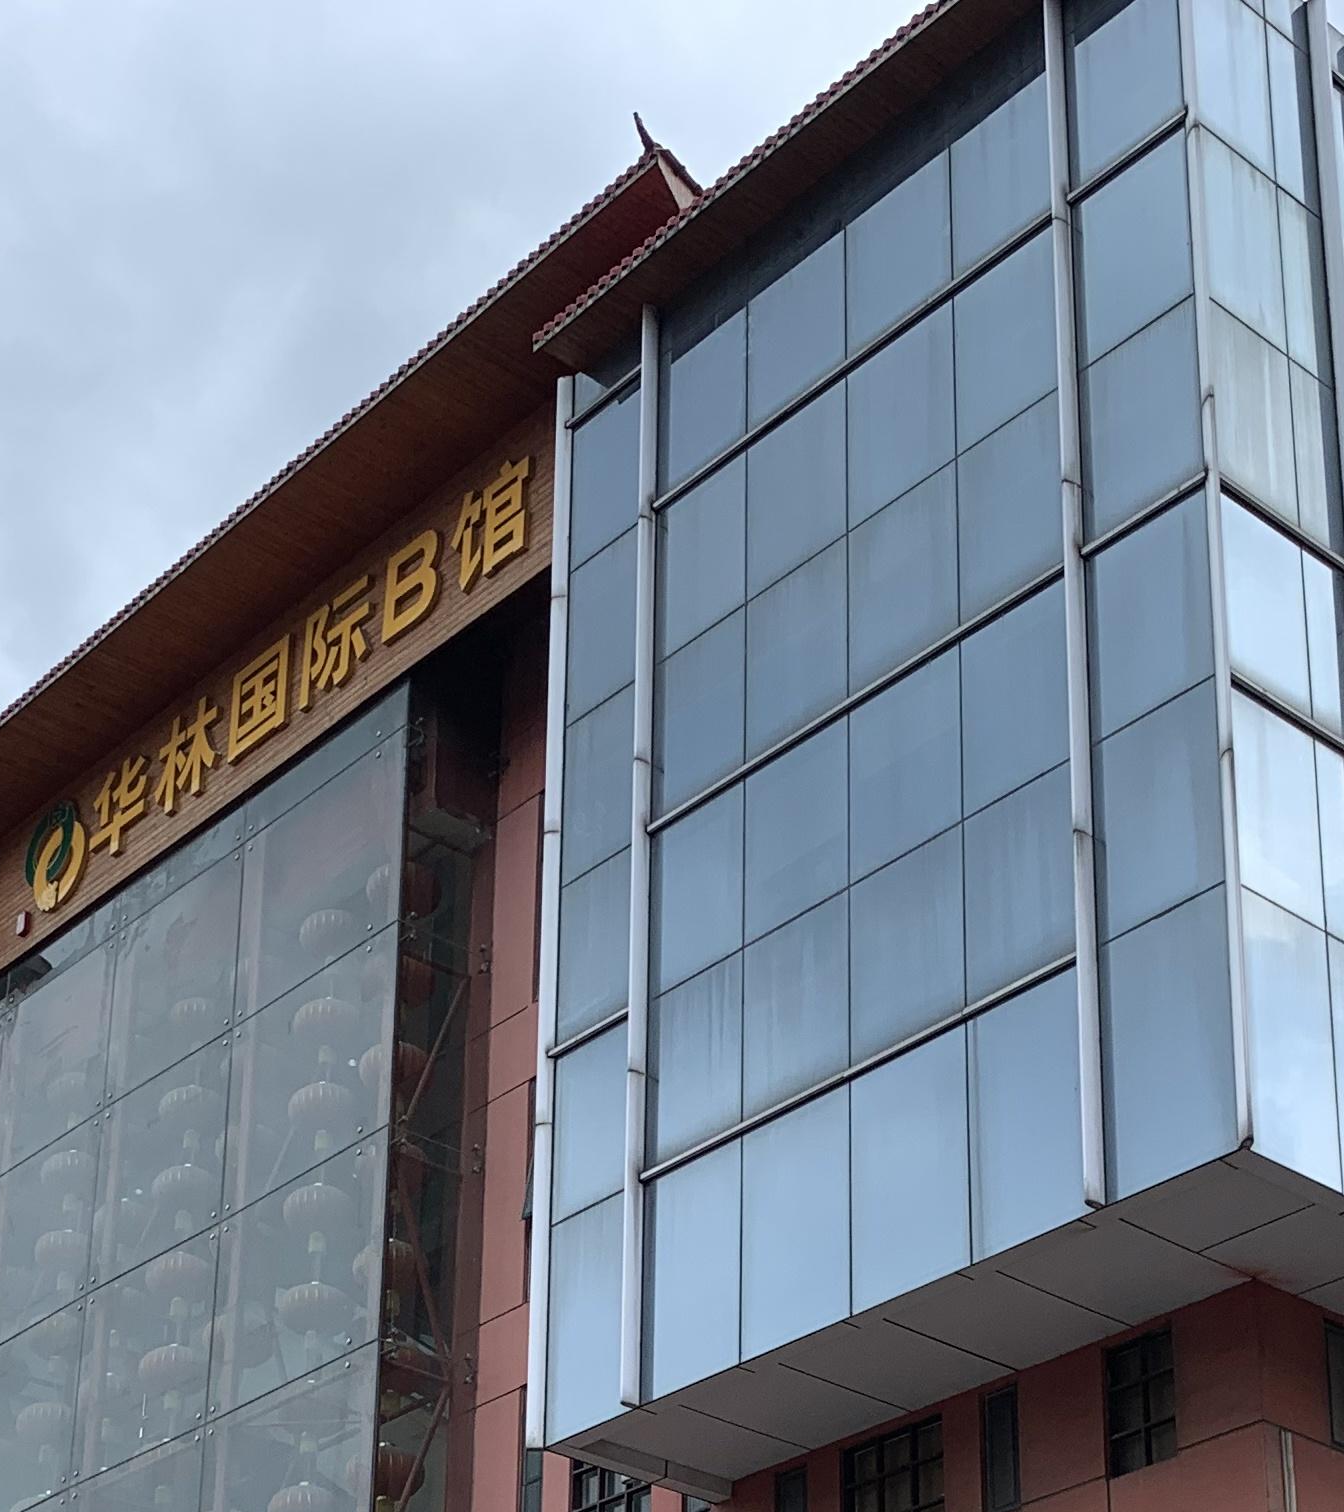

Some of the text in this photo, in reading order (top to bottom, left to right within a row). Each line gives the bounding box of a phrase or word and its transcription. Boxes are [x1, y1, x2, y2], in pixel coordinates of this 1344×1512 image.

[88, 453, 532, 858] 华林国际B馆
